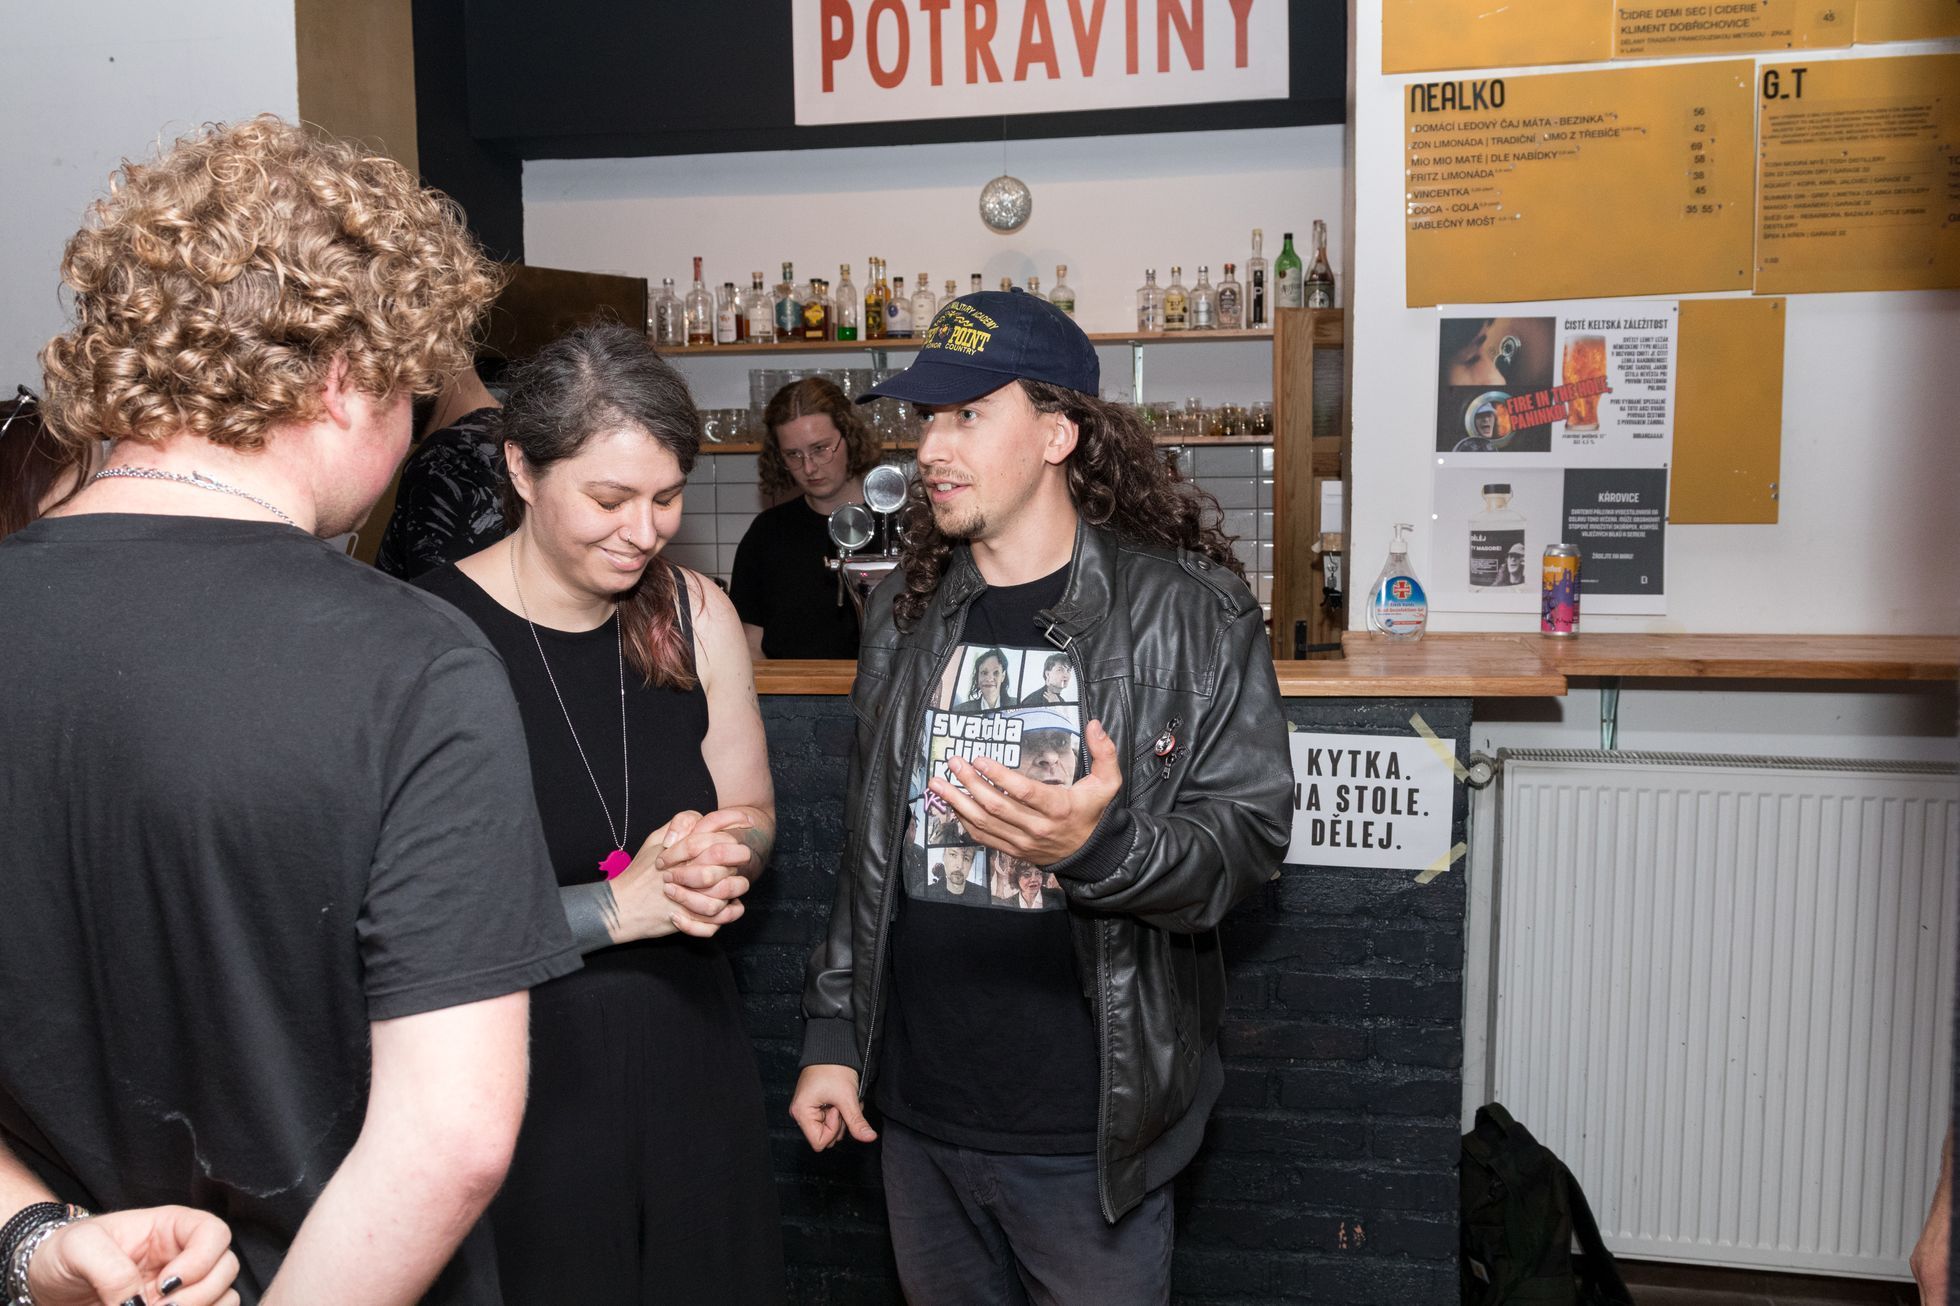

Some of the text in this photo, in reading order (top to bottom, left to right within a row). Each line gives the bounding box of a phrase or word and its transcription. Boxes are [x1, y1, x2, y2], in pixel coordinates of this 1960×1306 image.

[1621, 9, 1653, 20] CIDRE
[1655, 8, 1682, 18] DEMI
[1685, 6, 1706, 17] SEC
[1714, 3, 1757, 15] CIDERIE
[1621, 24, 1666, 35] KLIMENT
[820, 0, 1255, 93] POTRAVINY
[1411, 79, 1505, 112] NEALKO
[1415, 122, 1455, 133] DOMÁCÍ
[1457, 120, 1497, 131] LEDOVÝ
[1500, 118, 1519, 129] ČAJ
[1522, 117, 1551, 127] MÁTA
[1559, 114, 1604, 126] BEZINKA
[1411, 141, 1431, 150] ZON
[1434, 138, 1483, 149] LIMONÁDA
[1491, 134, 1536, 145] TRADIČNÍ
[1579, 128, 1620, 140] TŘEBÍČE
[1411, 158, 1431, 167] MIO
[1433, 156, 1453, 166] MIO
[1492, 153, 1510, 163] DLE
[1512, 150, 1557, 162] NABÍDKY
[1410, 169, 1494, 182] FRITZ LIMONÁDA
[1413, 187, 1470, 199] VINCENTKA
[1413, 205, 1443, 215] COCA
[1452, 203, 1479, 213] COLA
[1412, 215, 1496, 230] JABLEČNÝ MOŠT
[972, 311, 999, 330] ACADEMY
[1624, 317, 1669, 329] ZÁLEŽITOST
[948, 325, 992, 352] POINT
[944, 342, 977, 356] COUNTRY
[1506, 393, 1534, 415] FIRE
[1534, 390, 1550, 408] IN
[1551, 383, 1576, 403] THE
[1598, 491, 1640, 503] KÁROVICE
[1307, 748, 1411, 781] KYTKA.
[1336, 784, 1429, 817] STOLE.
[1311, 813, 1402, 850] DĚLEJ.
